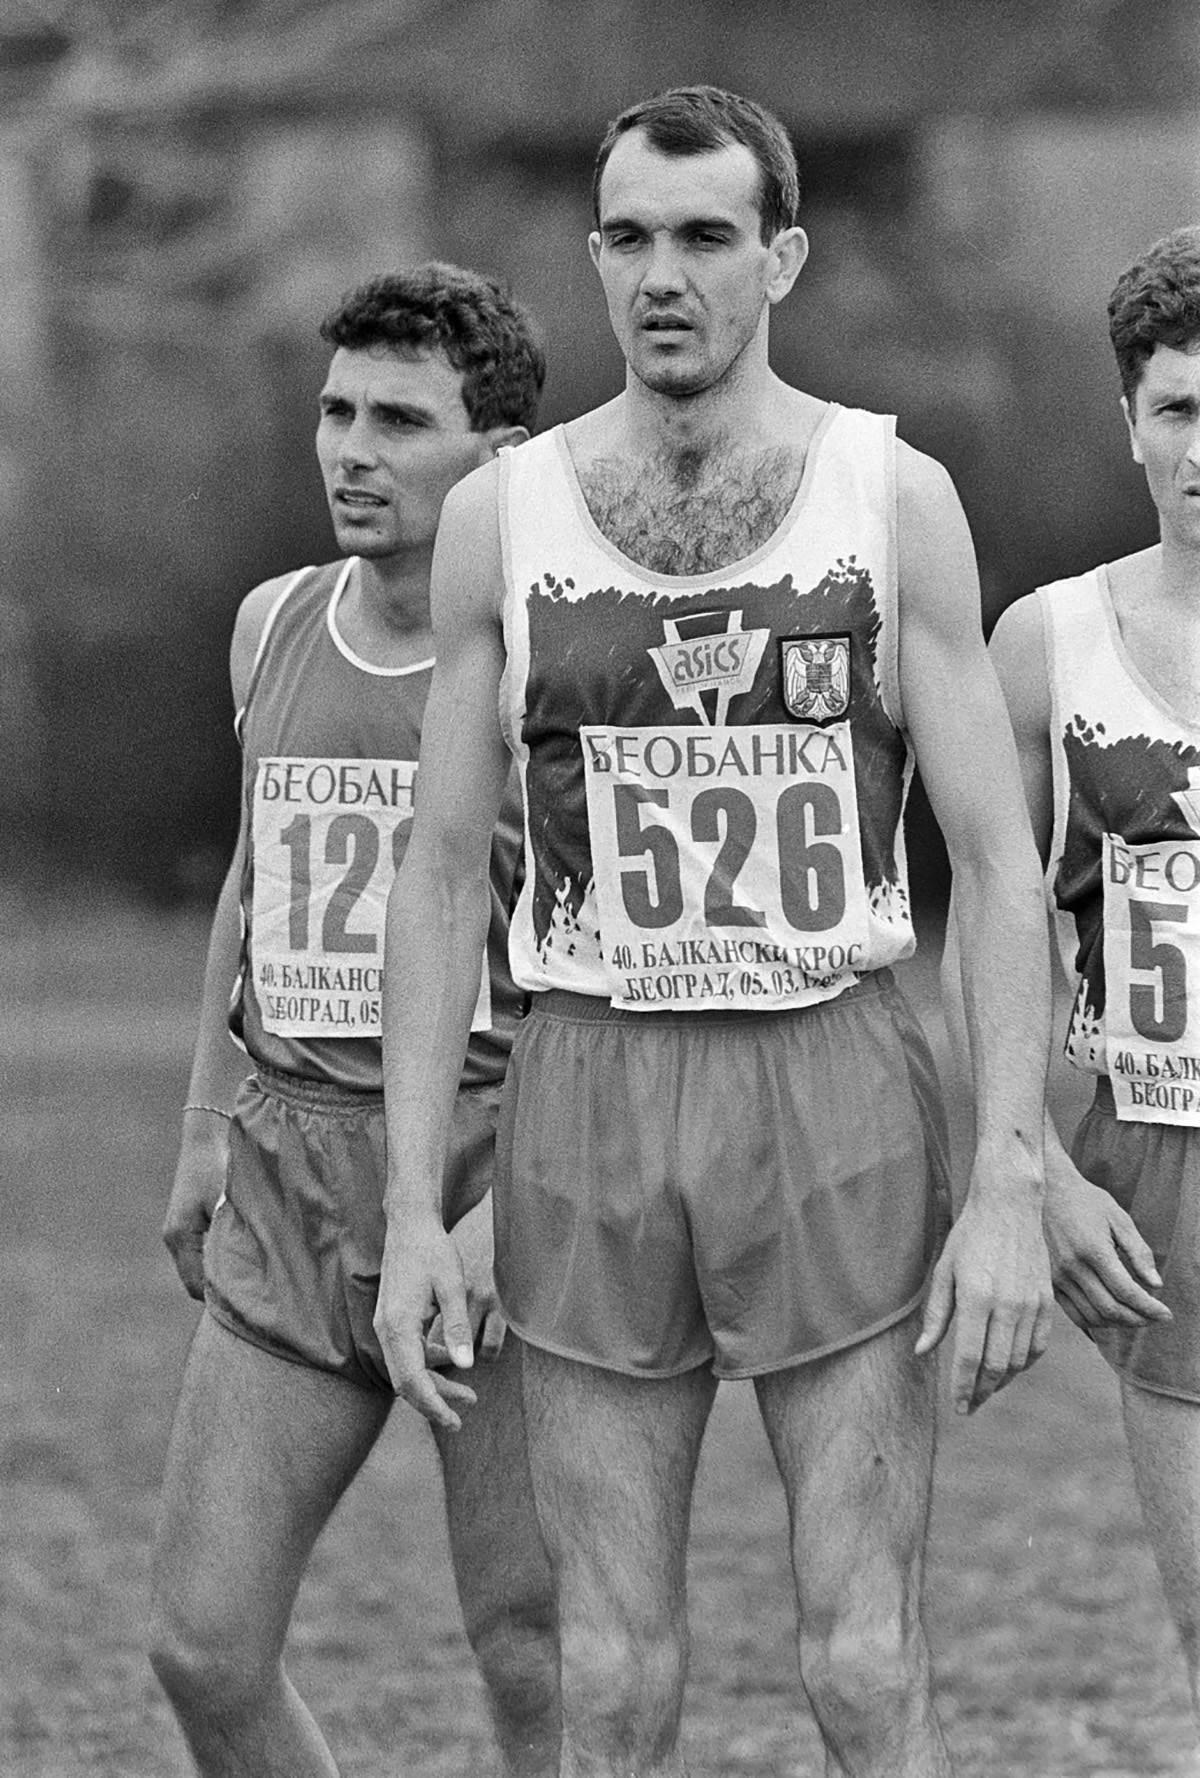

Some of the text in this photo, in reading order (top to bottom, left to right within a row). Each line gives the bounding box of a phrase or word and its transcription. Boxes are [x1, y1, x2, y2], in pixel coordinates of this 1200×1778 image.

[674, 639, 740, 681] asics
[586, 734, 847, 778] БЕОБАНКА
[613, 781, 846, 933] 526
[280, 813, 414, 954] 12
[260, 963, 277, 987] 40.
[612, 940, 862, 971] 40. БАЛКАНСКИ КРОС
[1129, 898, 1189, 1043] 5
[1114, 1051, 1141, 1075] 40.
